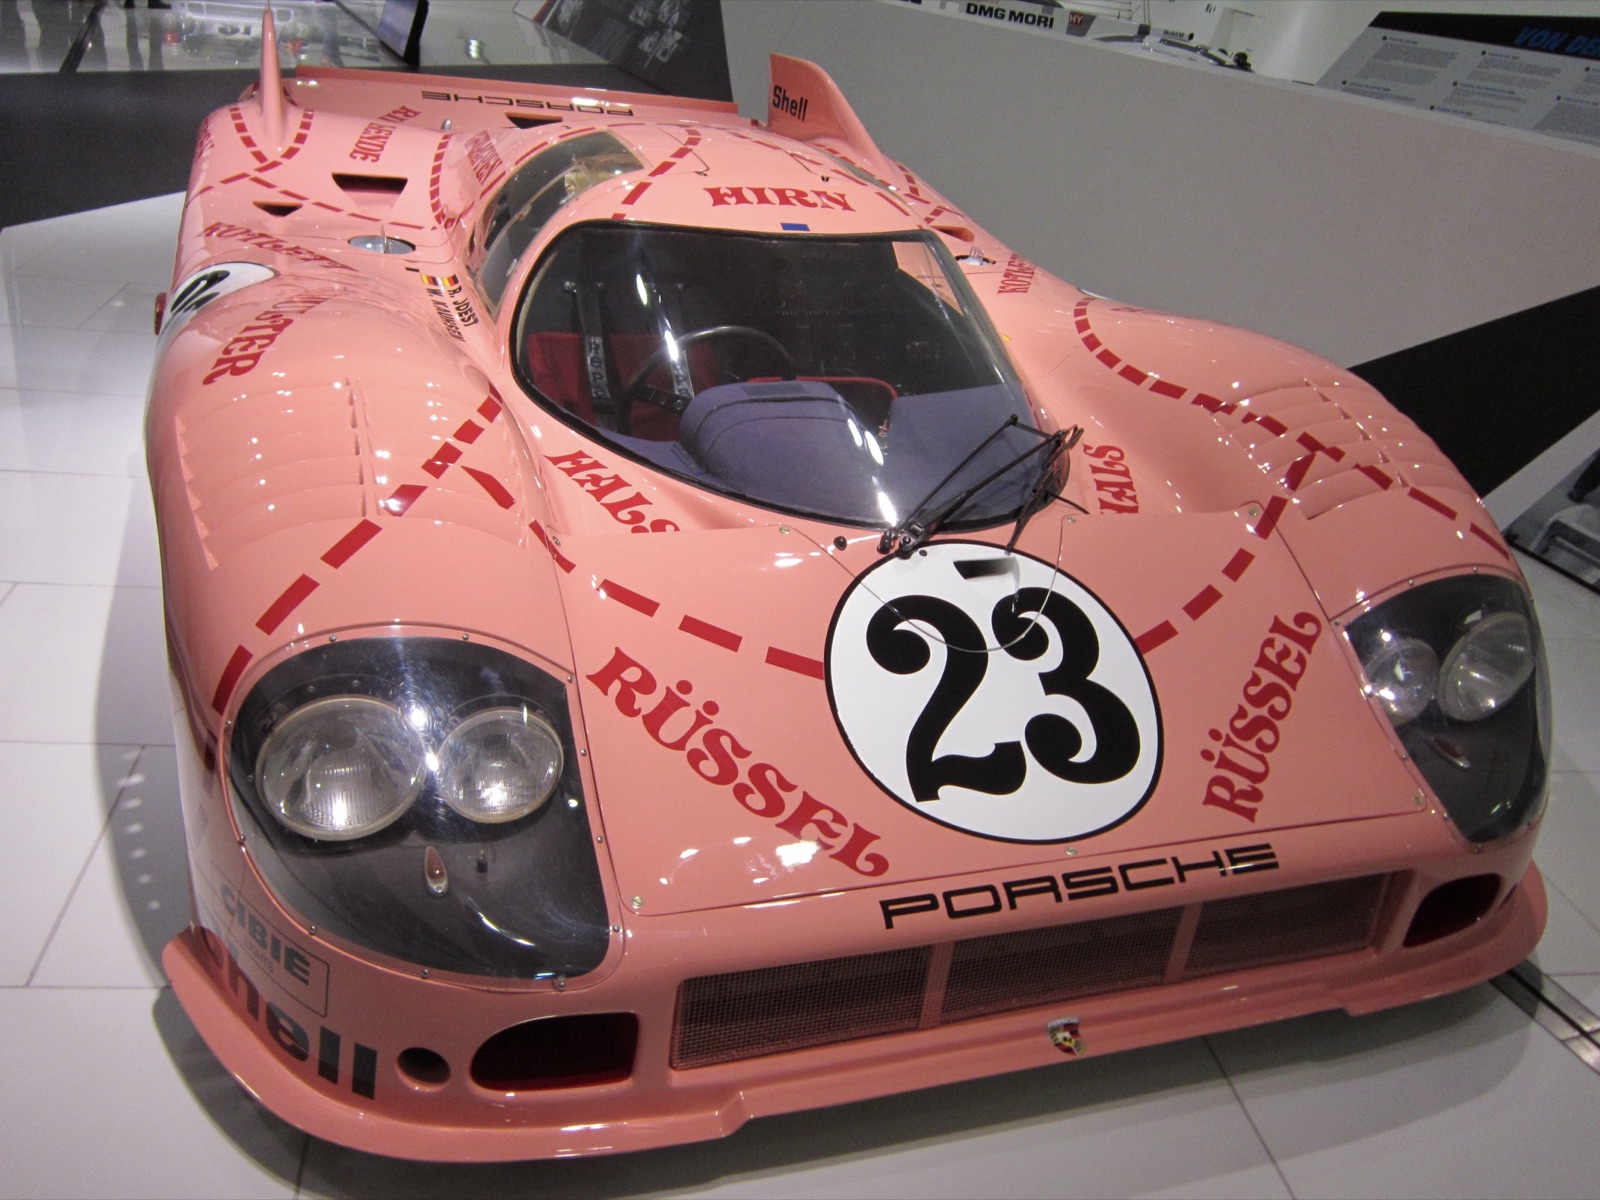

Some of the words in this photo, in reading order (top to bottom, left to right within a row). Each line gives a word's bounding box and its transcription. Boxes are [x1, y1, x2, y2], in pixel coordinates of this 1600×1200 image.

[966, 2, 1006, 20] DMG
[1008, 9, 1055, 29] MORI
[1514, 26, 1569, 52] VON
[421, 90, 634, 117] PORSCHE
[772, 85, 808, 122] Shell
[703, 186, 856, 212] HIRN
[447, 285, 462, 298] R.
[452, 298, 479, 327] JOEST
[866, 586, 1141, 803] 23
[1201, 611, 1322, 823] RÜSSEL
[586, 646, 890, 877] RÜSSEL
[879, 843, 1280, 930] PORSCHE
[221, 883, 310, 986] CIBIE
